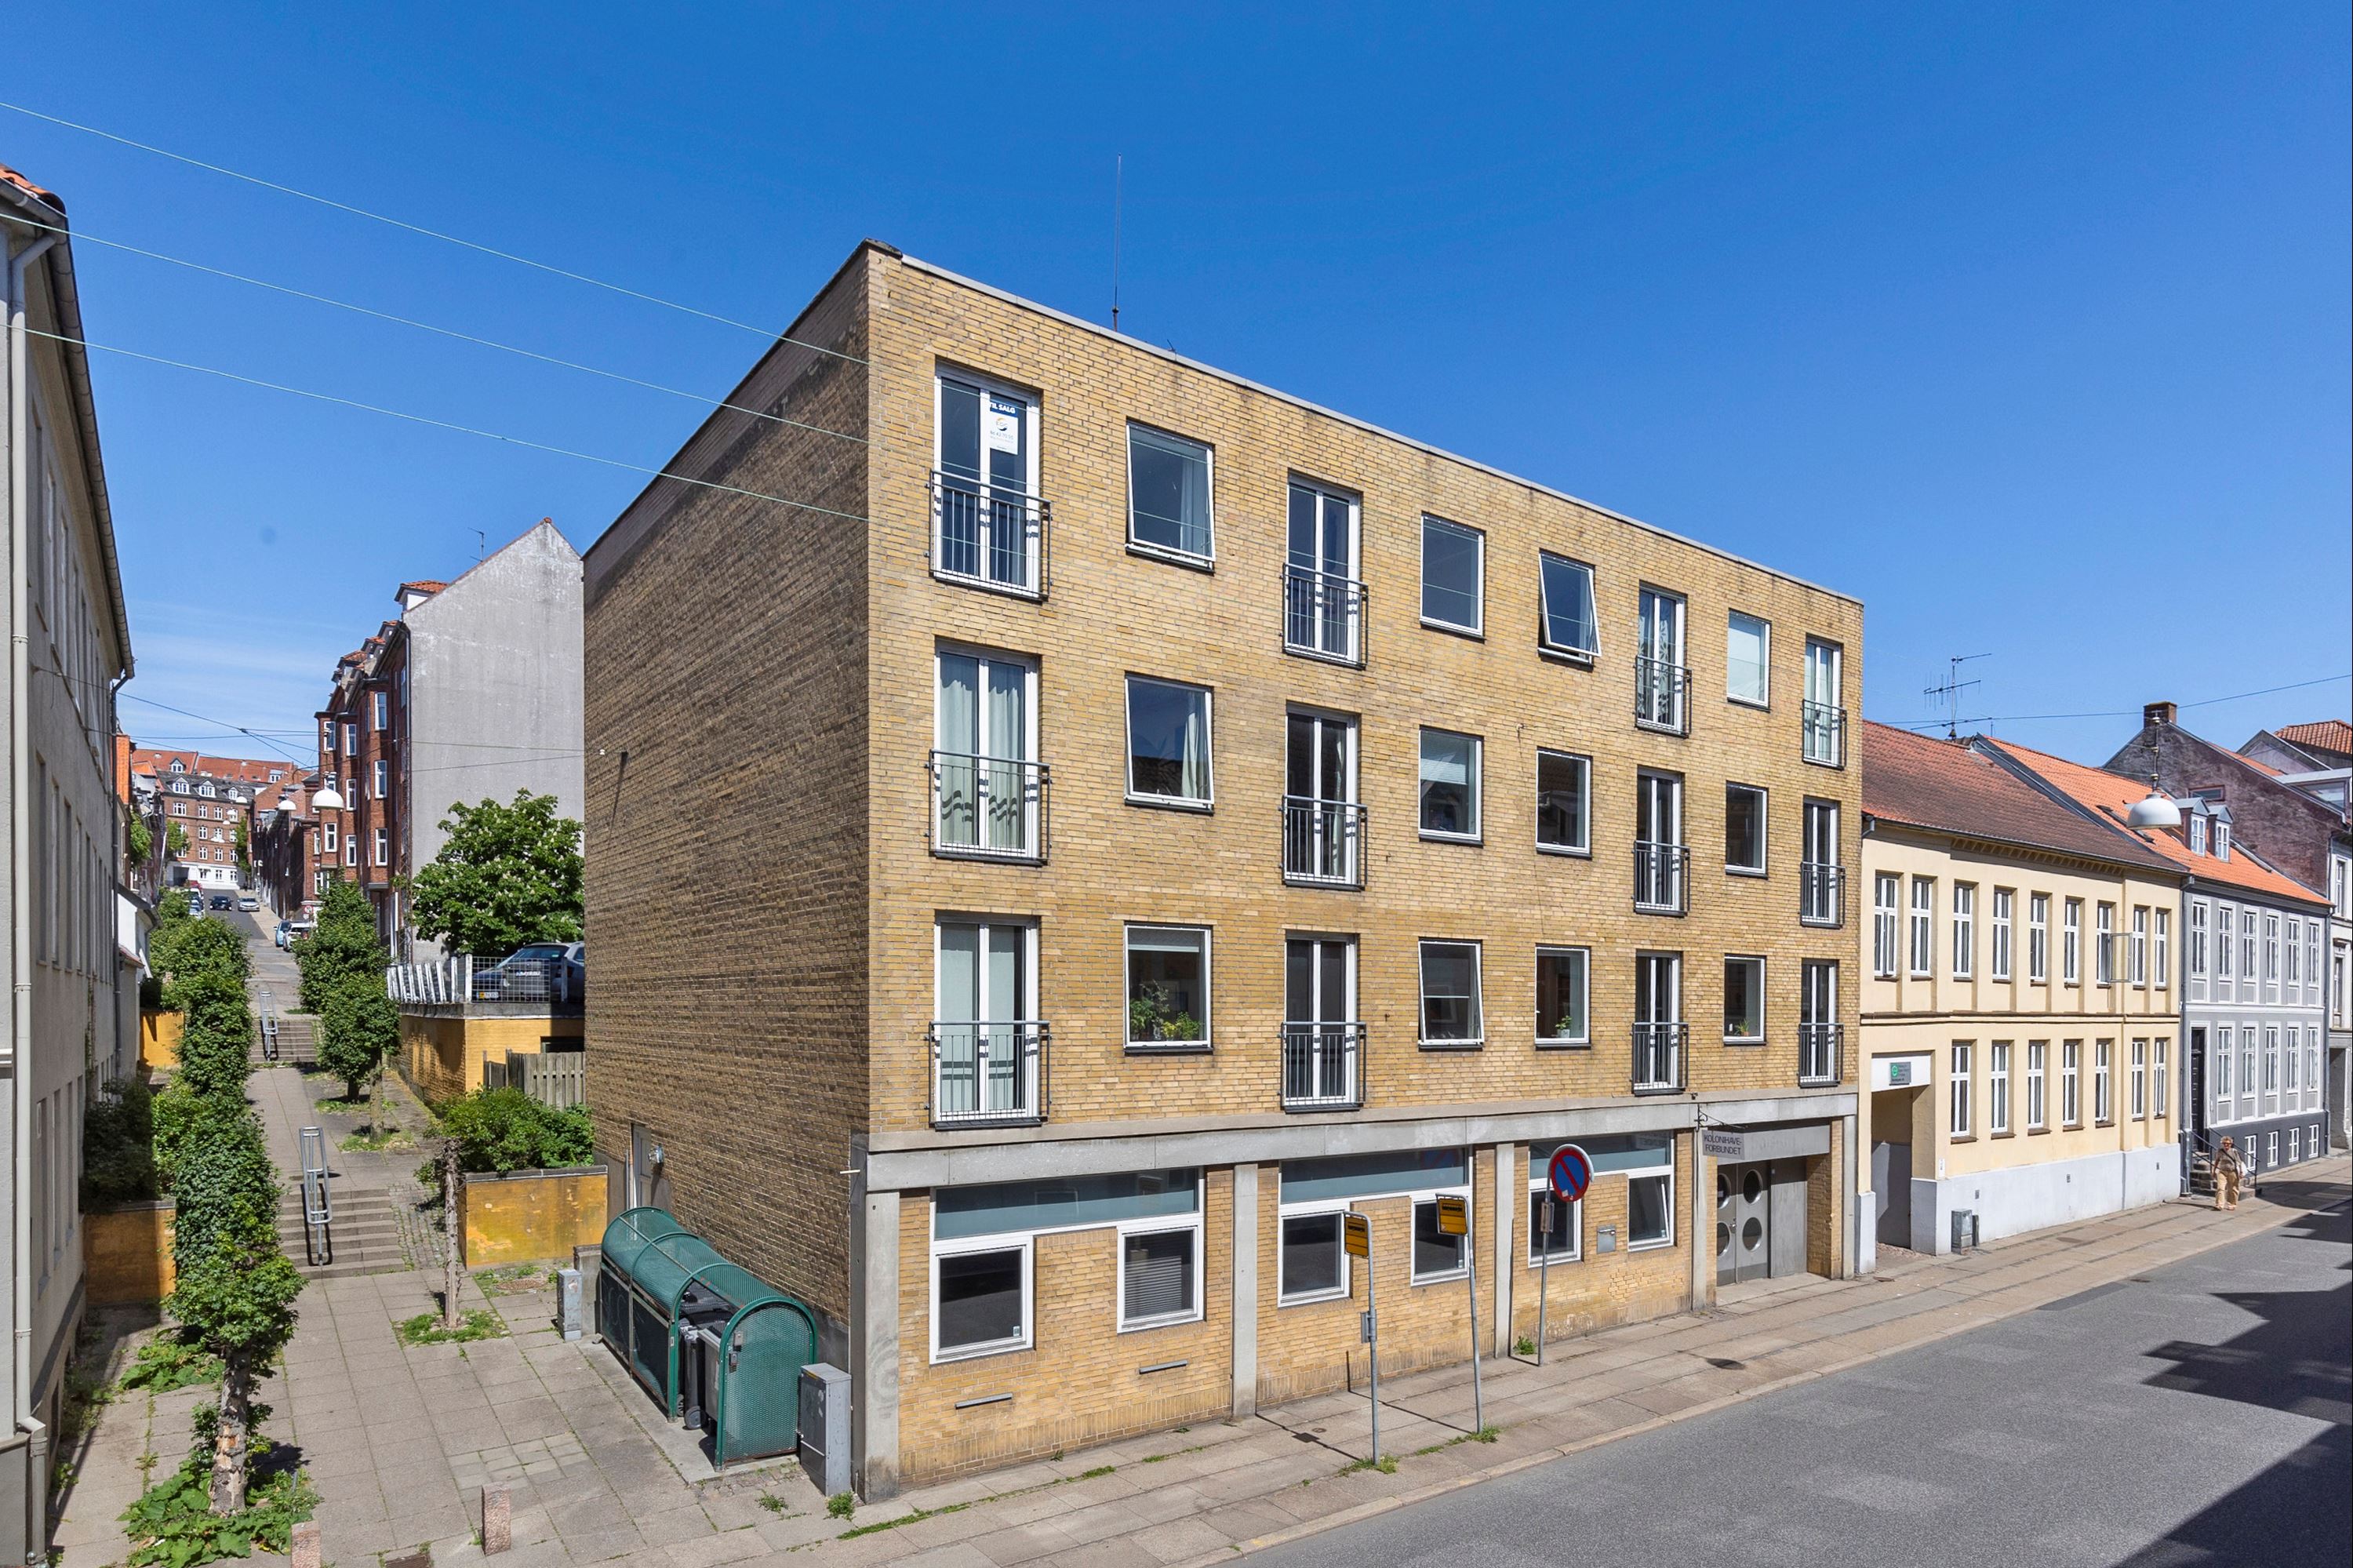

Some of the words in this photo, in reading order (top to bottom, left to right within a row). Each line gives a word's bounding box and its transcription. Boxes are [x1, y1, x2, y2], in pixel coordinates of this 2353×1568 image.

[998, 404, 1016, 414] SALG
[1704, 1134, 1742, 1145] KOLONIHAVE-
[1705, 1144, 1741, 1155] FORBUNDET
